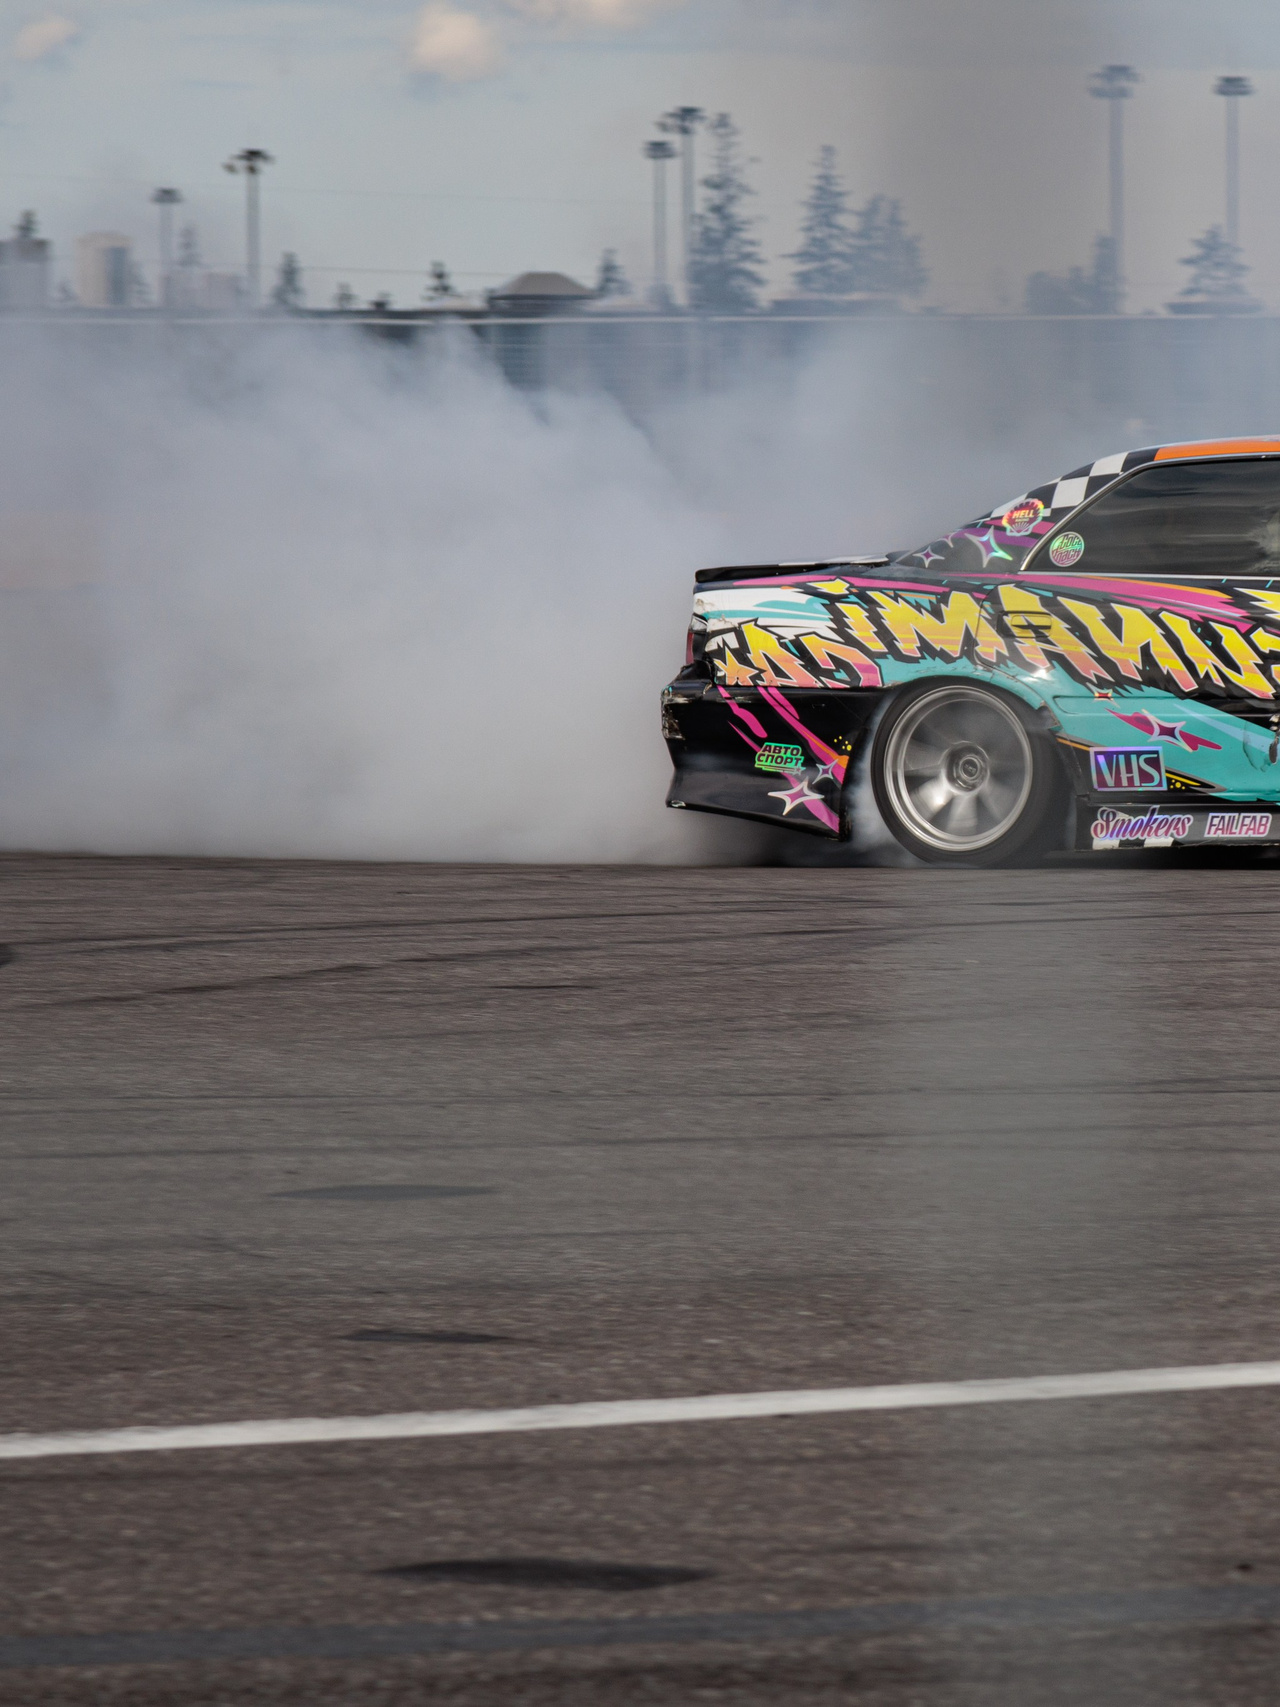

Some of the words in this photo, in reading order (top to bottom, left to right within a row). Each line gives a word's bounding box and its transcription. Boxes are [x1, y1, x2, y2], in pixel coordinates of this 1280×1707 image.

[757, 753, 802, 766] СПОРТ
[762, 745, 801, 756] АВТО
[1096, 753, 1160, 787] VHS
[1092, 805, 1192, 840] Smokers
